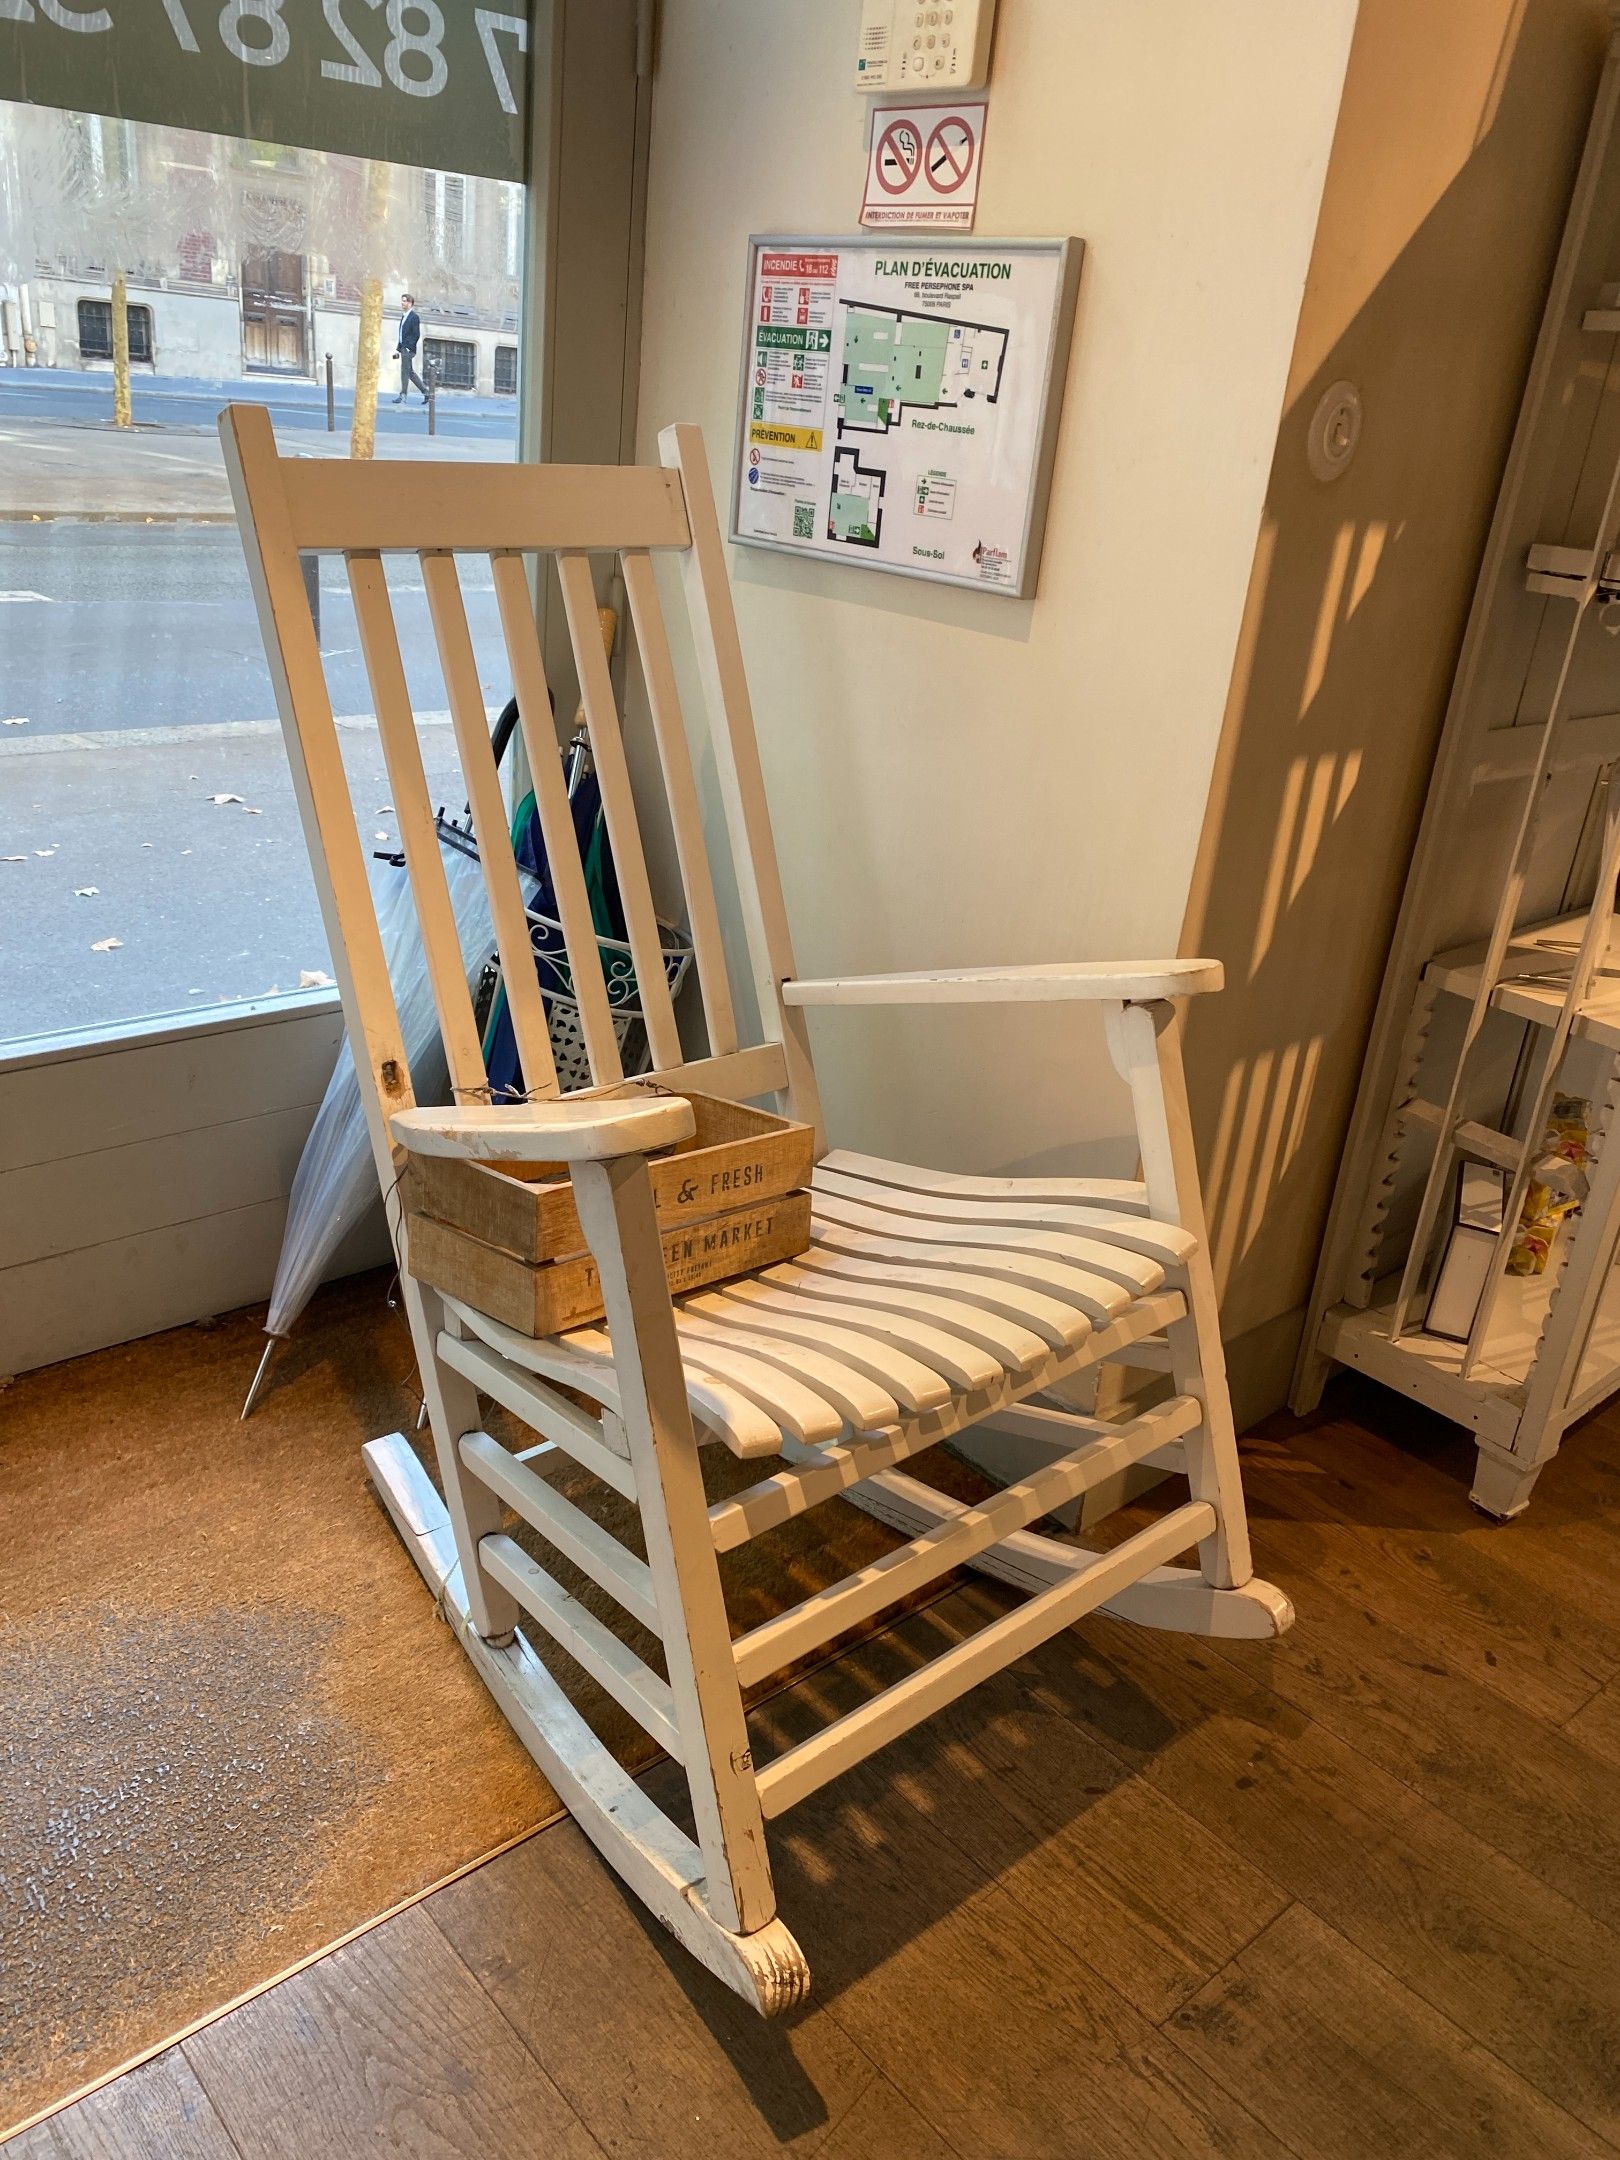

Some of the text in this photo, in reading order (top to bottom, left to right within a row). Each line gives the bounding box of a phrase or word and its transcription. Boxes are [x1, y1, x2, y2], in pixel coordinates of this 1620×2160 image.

[865, 211, 905, 219] INTERDICTION
[763, 259, 798, 271] INCENDIE
[819, 264, 829, 274] 112
[874, 257, 1012, 279] PLAN D'ÉVACUATION
[904, 281, 974, 291] FREE PERSEPHONE SPA
[911, 419, 975, 435] Rez-de-Chaussée
[912, 546, 945, 560] Sous-Sol
[711, 1164, 763, 1195] FRESH
[704, 1217, 773, 1253] MARKET
